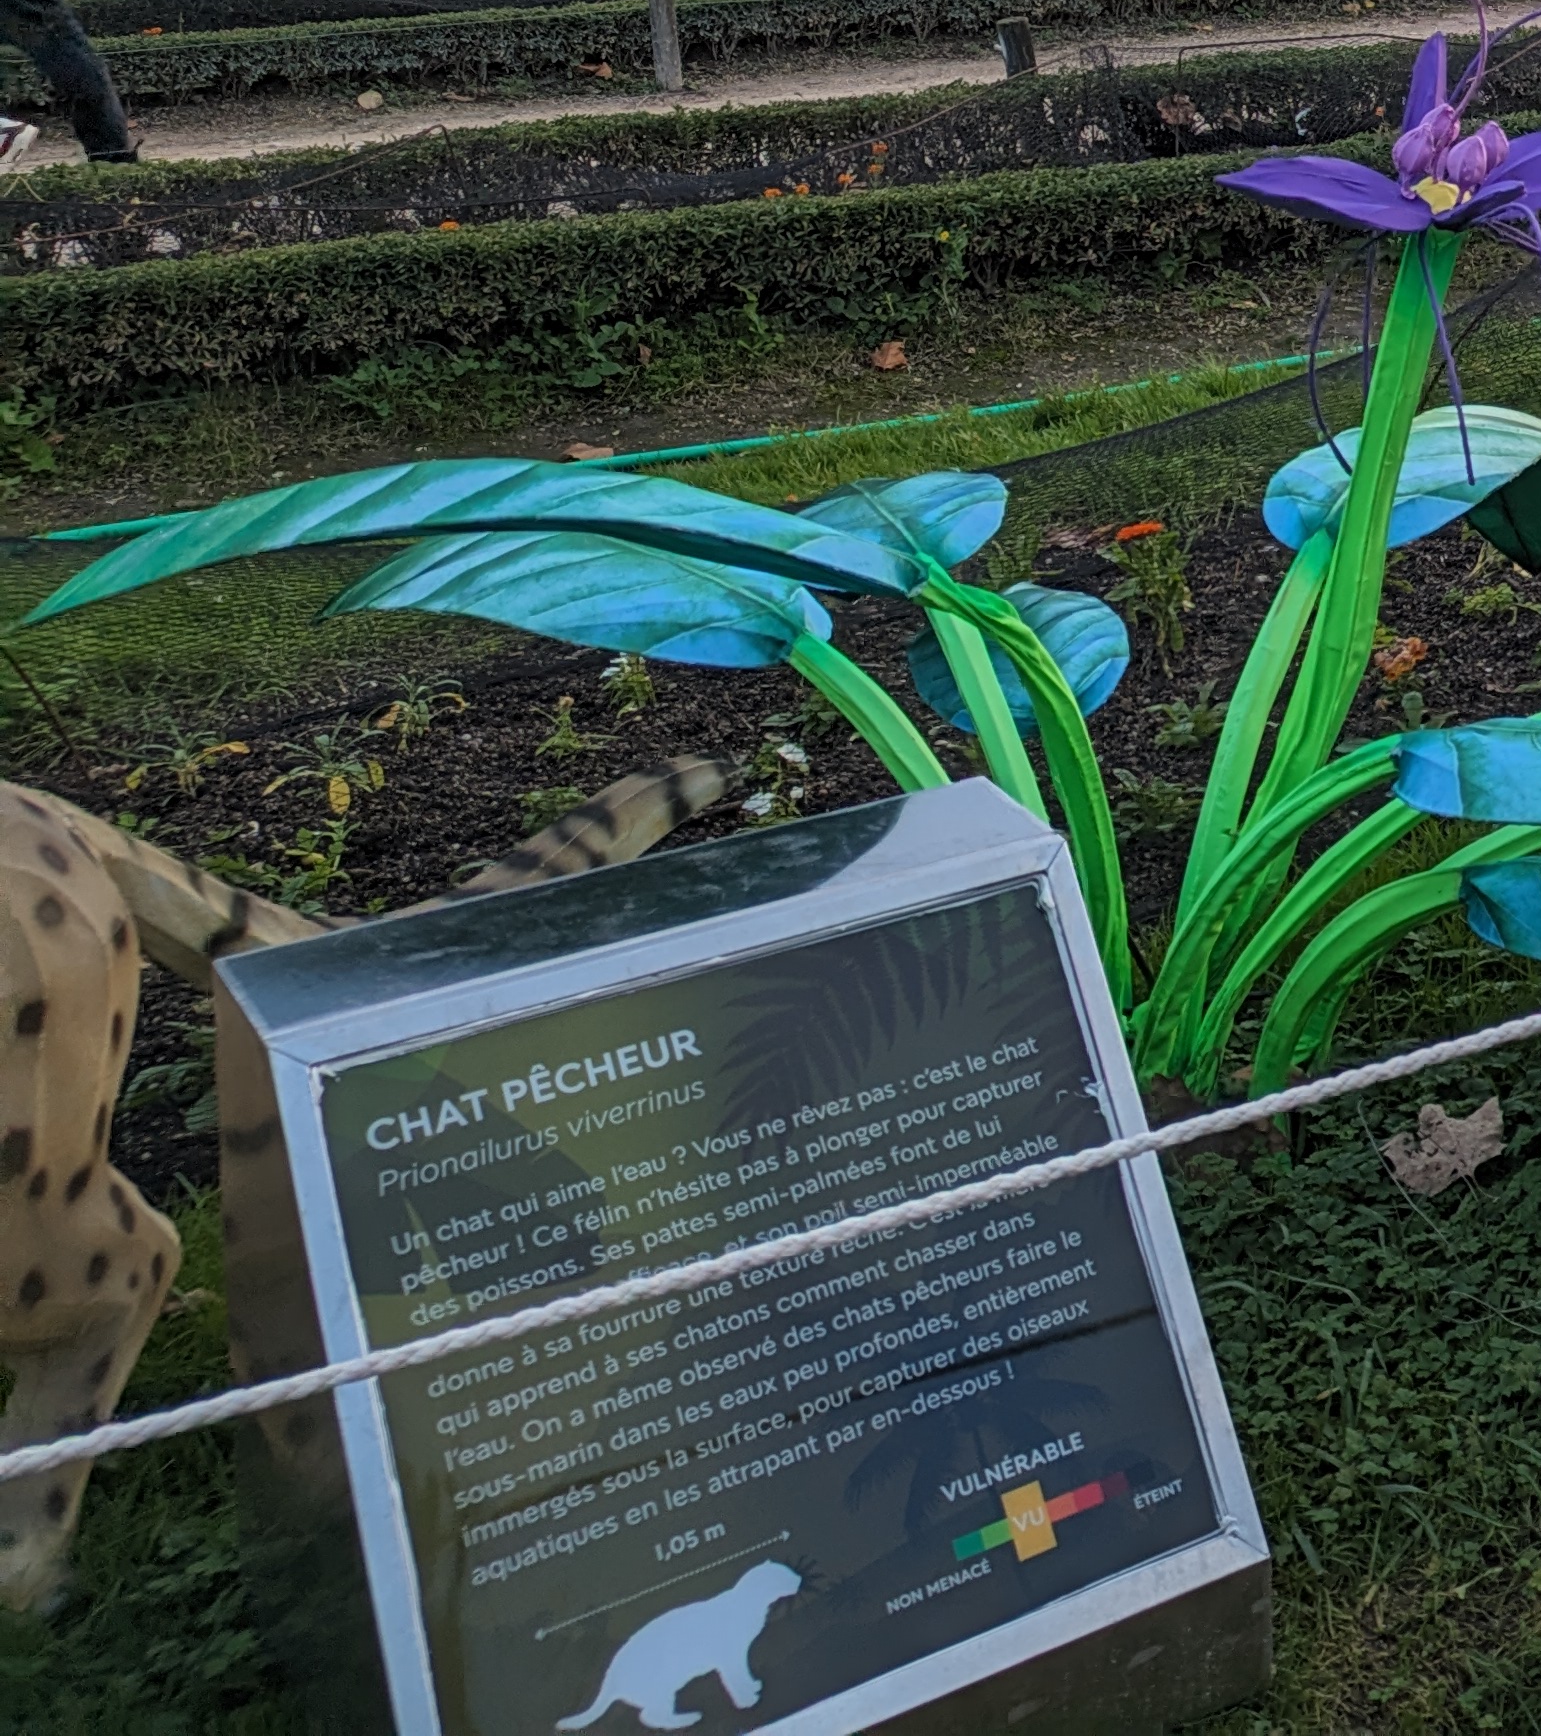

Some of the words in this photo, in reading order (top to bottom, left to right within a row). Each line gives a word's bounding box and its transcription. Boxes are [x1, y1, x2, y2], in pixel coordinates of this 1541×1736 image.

[366, 1088, 488, 1150] CHAT
[502, 1029, 702, 1111] PÊCHEUR
[378, 1125, 558, 1197] Prionailurus
[567, 1080, 705, 1137] viverrinus
[391, 1229, 429, 1255] Un
[436, 1208, 494, 1242] chat
[500, 1193, 539, 1223] qui
[546, 1174, 605, 1207] aime
[610, 1155, 667, 1186] l'eau
[671, 1145, 687, 1166] ?
[692, 1129, 751, 1158] Vous
[756, 1118, 786, 1139] ne
[792, 1098, 852, 1128] rêvez
[856, 1082, 896, 1111] pas
[900, 1079, 908, 1094] :
[913, 1060, 963, 1090] c'est
[966, 1052, 987, 1074] le
[992, 1037, 1039, 1065] chat
[401, 1240, 510, 1295] pêcheur
[516, 1234, 526, 1254] !
[531, 1220, 568, 1248] Ce
[573, 1204, 629, 1236] félin
[636, 1169, 731, 1215] n'hésite
[738, 1155, 780, 1186] pas
[785, 1146, 801, 1165] à
[805, 1118, 890, 1163] plonger
[896, 1102, 946, 1133] pour
[952, 1069, 1043, 1115] capturer
[410, 1296, 460, 1327] des
[466, 1258, 586, 1311] poissons.
[589, 1238, 636, 1266] Ses
[641, 1212, 717, 1254] pattes
[723, 1154, 886, 1223] semi-palmées
[889, 1137, 938, 1167] font
[942, 1123, 971, 1148] de
[975, 1115, 1002, 1139] lui
[804, 1201, 846, 1230] poil
[853, 1134, 1059, 1213] semi-imperméable
[427, 1354, 514, 1399] donne
[522, 1344, 538, 1365] à
[545, 1336, 573, 1358] sa
[578, 1298, 682, 1346] fourrure
[687, 1279, 733, 1306] une
[739, 1246, 825, 1289] texture
[437, 1404, 479, 1436] qui
[487, 1361, 597, 1420] apprend
[604, 1354, 620, 1375] à
[628, 1342, 667, 1366] ses
[673, 1305, 770, 1355] chatons
[777, 1261, 889, 1314] comment
[895, 1231, 977, 1272] chasser
[982, 1210, 1035, 1242] dans
[444, 1439, 515, 1473] l'eau.
[521, 1417, 562, 1443] On
[570, 1409, 586, 1426] a
[592, 1374, 672, 1419] même
[679, 1336, 777, 1387] observé
[783, 1317, 827, 1350] des
[832, 1294, 895, 1331] chats
[901, 1259, 1000, 1311] pêcheurs
[1006, 1237, 1056, 1270] faire
[1060, 1229, 1082, 1249] le
[454, 1439, 603, 1510] sous-marin
[609, 1414, 671, 1452] dans
[676, 1400, 713, 1427] les
[719, 1379, 778, 1411] eaux
[783, 1355, 828, 1393] peu
[834, 1311, 959, 1369] profondes,
[963, 1258, 1097, 1321] entièrement
[461, 1485, 596, 1548] immergés
[602, 1462, 660, 1495] sous
[665, 1448, 688, 1470] la
[695, 1410, 793, 1461] surface,
[798, 1386, 853, 1424] pour
[858, 1346, 956, 1397] capturer
[961, 1326, 1003, 1356] des
[1007, 1298, 1090, 1342] oiseaux
[471, 1518, 619, 1587] aquatiques
[625, 1501, 658, 1526] en
[664, 1481, 701, 1509] les
[708, 1433, 820, 1497] attrapant
[825, 1419, 865, 1449] par
[871, 1370, 1001, 1432] en-dessous
[1005, 1361, 1015, 1381] !
[940, 1430, 1084, 1505] VULNÉRABLE
[1133, 1478, 1183, 1511] ÉTEINT
[654, 1528, 700, 1562] 1,05
[704, 1523, 726, 1541] m
[886, 1588, 925, 1615] NON
[925, 1557, 992, 1599] MENACÉ
[1012, 1507, 1046, 1534] VU
